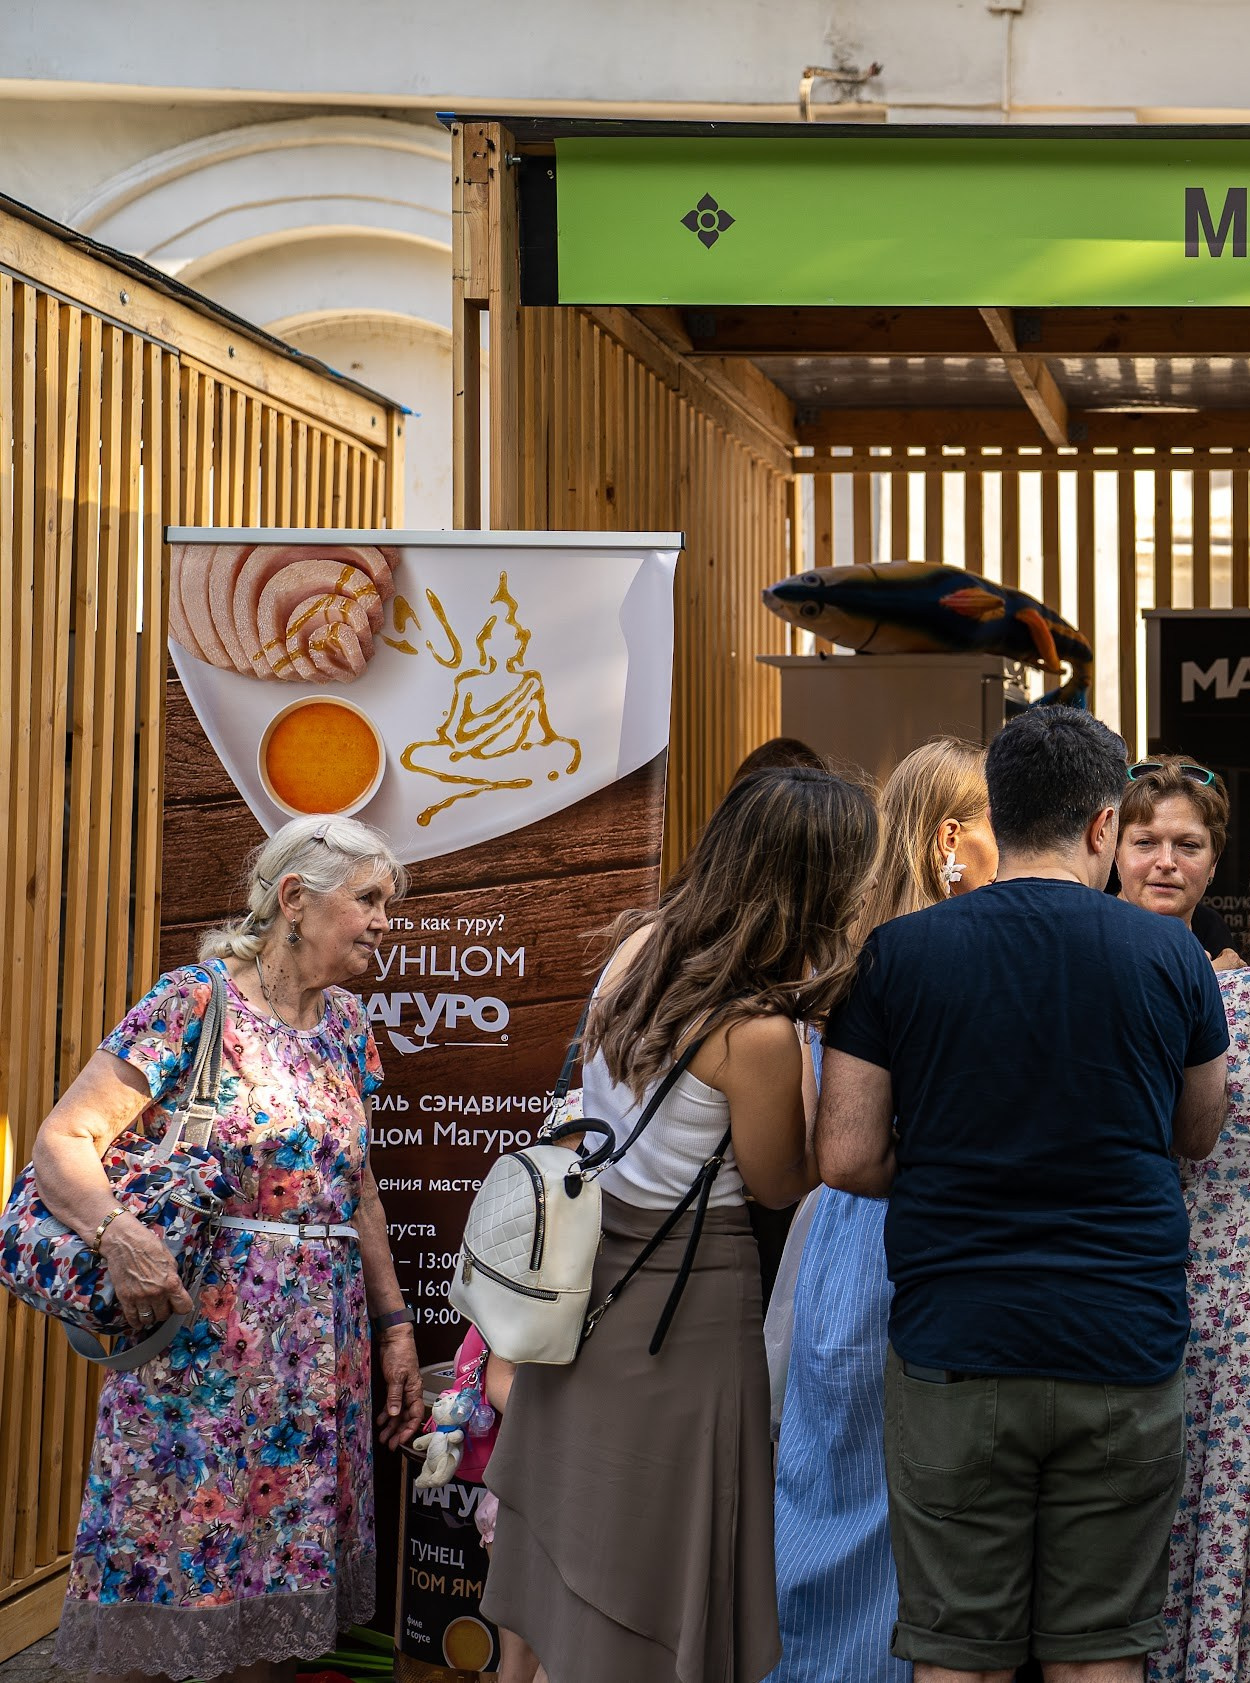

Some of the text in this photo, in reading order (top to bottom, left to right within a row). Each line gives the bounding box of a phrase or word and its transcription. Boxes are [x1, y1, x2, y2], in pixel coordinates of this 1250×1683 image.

[388, 914, 505, 936] ить как гуру?
[374, 945, 525, 981] УНЦОМ
[357, 993, 510, 1037] АГУРО
[371, 1094, 409, 1112] аль
[371, 1122, 531, 1153] цом Магуро
[376, 1178, 482, 1192] ения масте
[418, 1281, 450, 1296] 16:0
[416, 1308, 461, 1324] 19:00
[410, 1538, 465, 1570] ТУНЕЦ
[409, 1566, 483, 1599] ТОМ ЯМ
[406, 1614, 423, 1629] филе
[411, 1631, 431, 1644] соусе
